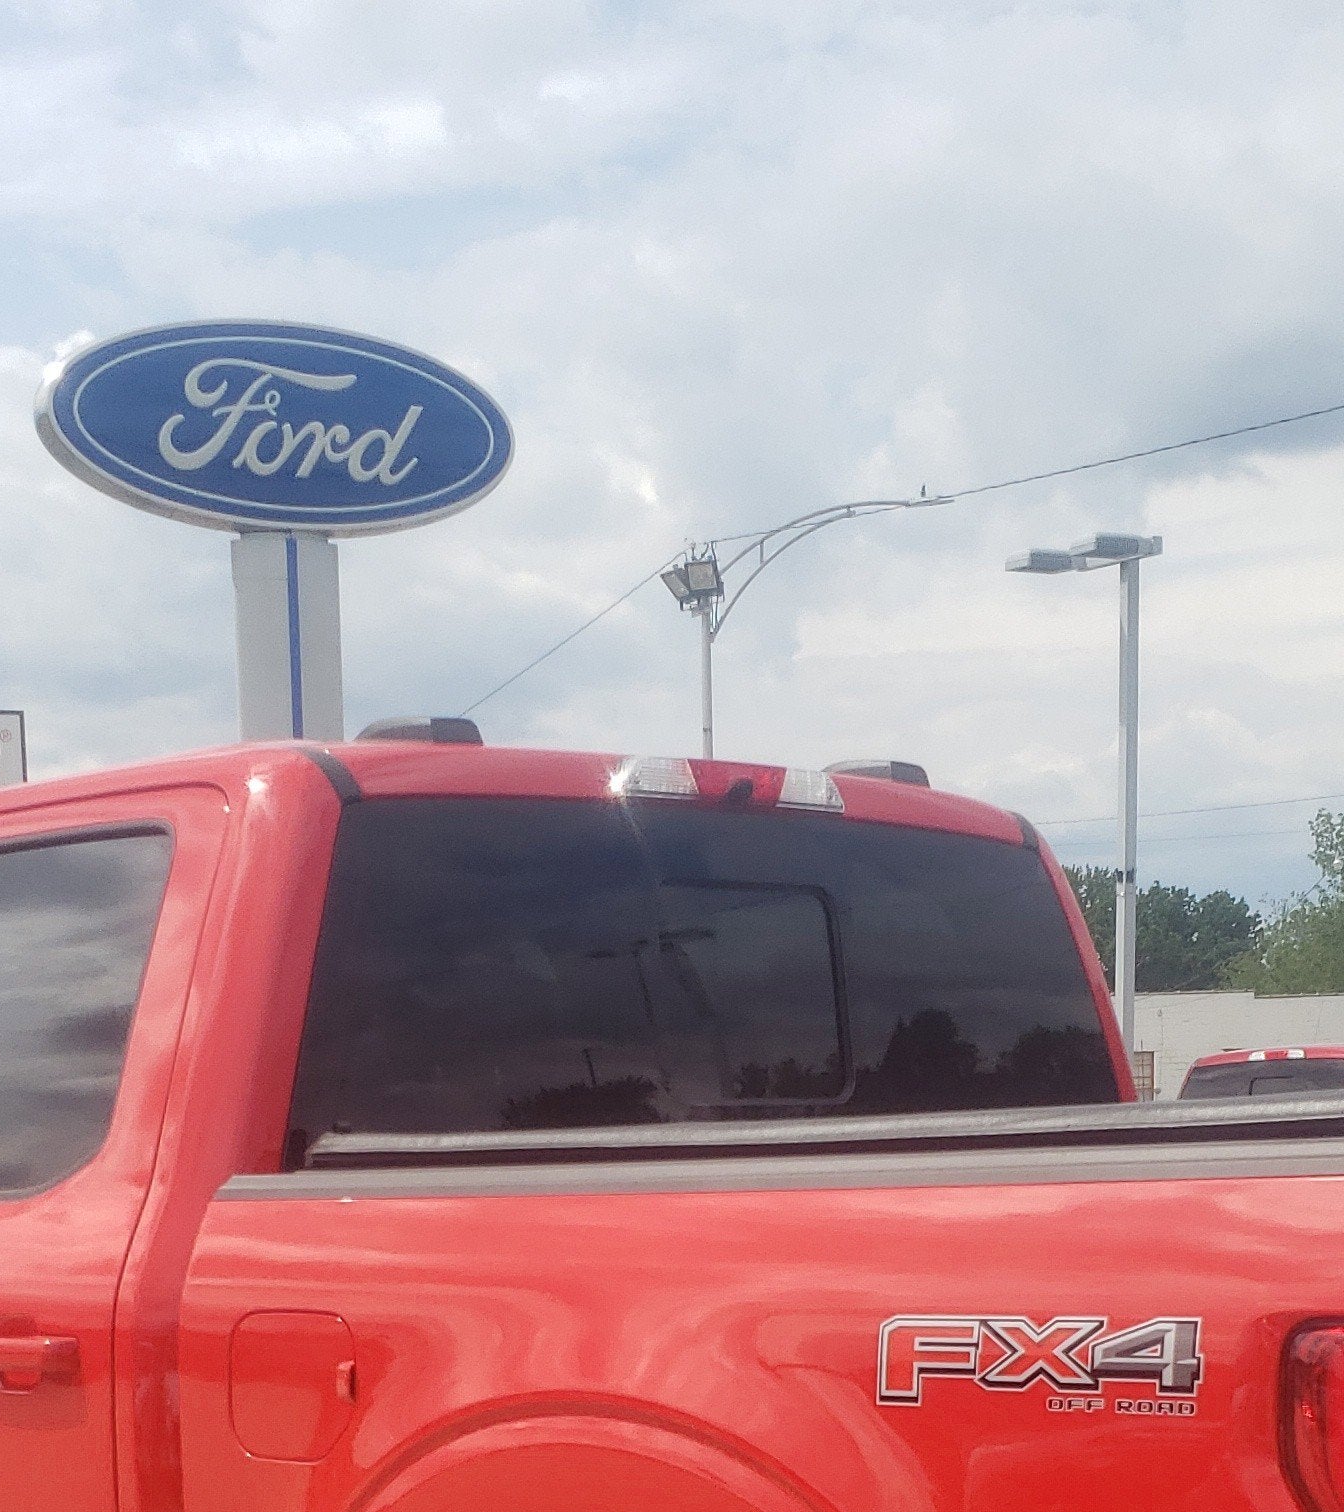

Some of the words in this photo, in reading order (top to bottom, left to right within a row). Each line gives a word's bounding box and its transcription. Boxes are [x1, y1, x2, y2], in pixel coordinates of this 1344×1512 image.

[159, 357, 424, 486] Ford
[875, 1314, 1205, 1407] FX4
[1046, 1396, 1104, 1413] OFF
[1115, 1399, 1197, 1416] ROAD
